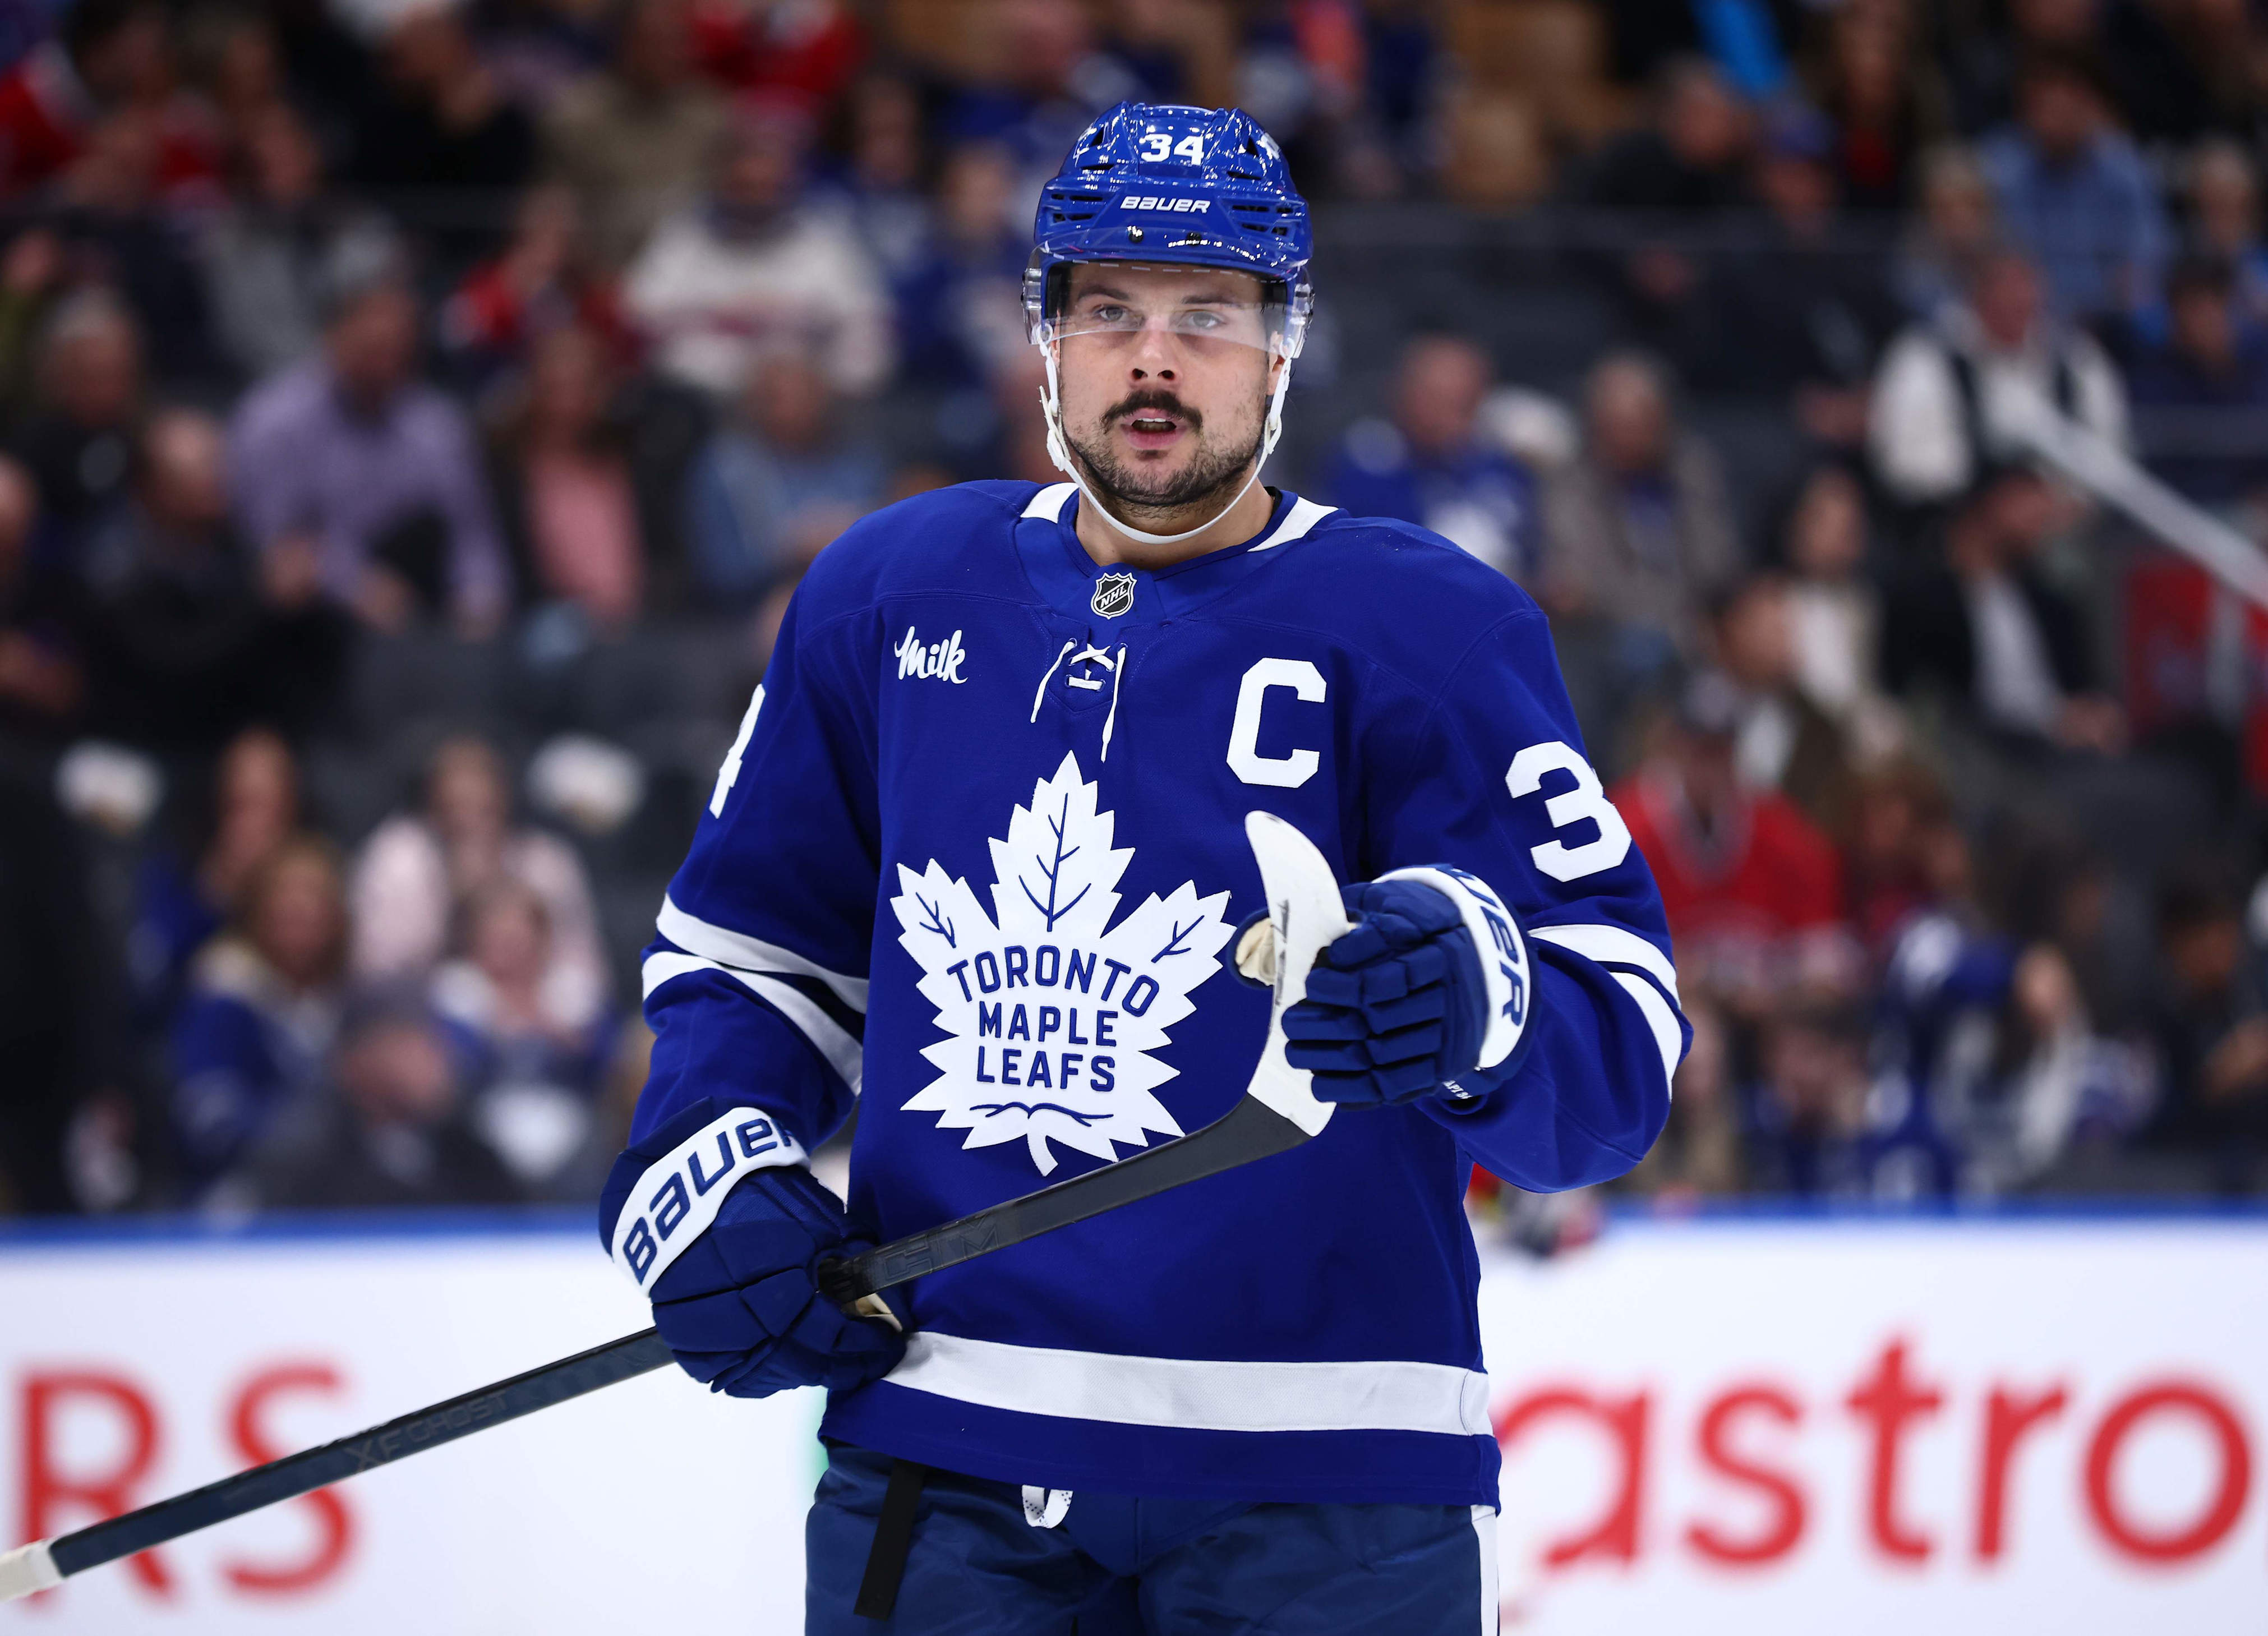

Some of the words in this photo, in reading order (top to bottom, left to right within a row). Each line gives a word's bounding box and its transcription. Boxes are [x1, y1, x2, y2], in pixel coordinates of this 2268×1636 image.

[1140, 133, 1204, 165] 34
[1100, 585, 1127, 609] NHL
[895, 626, 968, 684] Milk
[1226, 657, 1327, 789] C
[946, 944, 1160, 1017] TORONTO
[979, 1001, 1118, 1047] MAPLE
[976, 1045, 1115, 1093] LEAFS
[1486, 1329, 2268, 1570] astro
